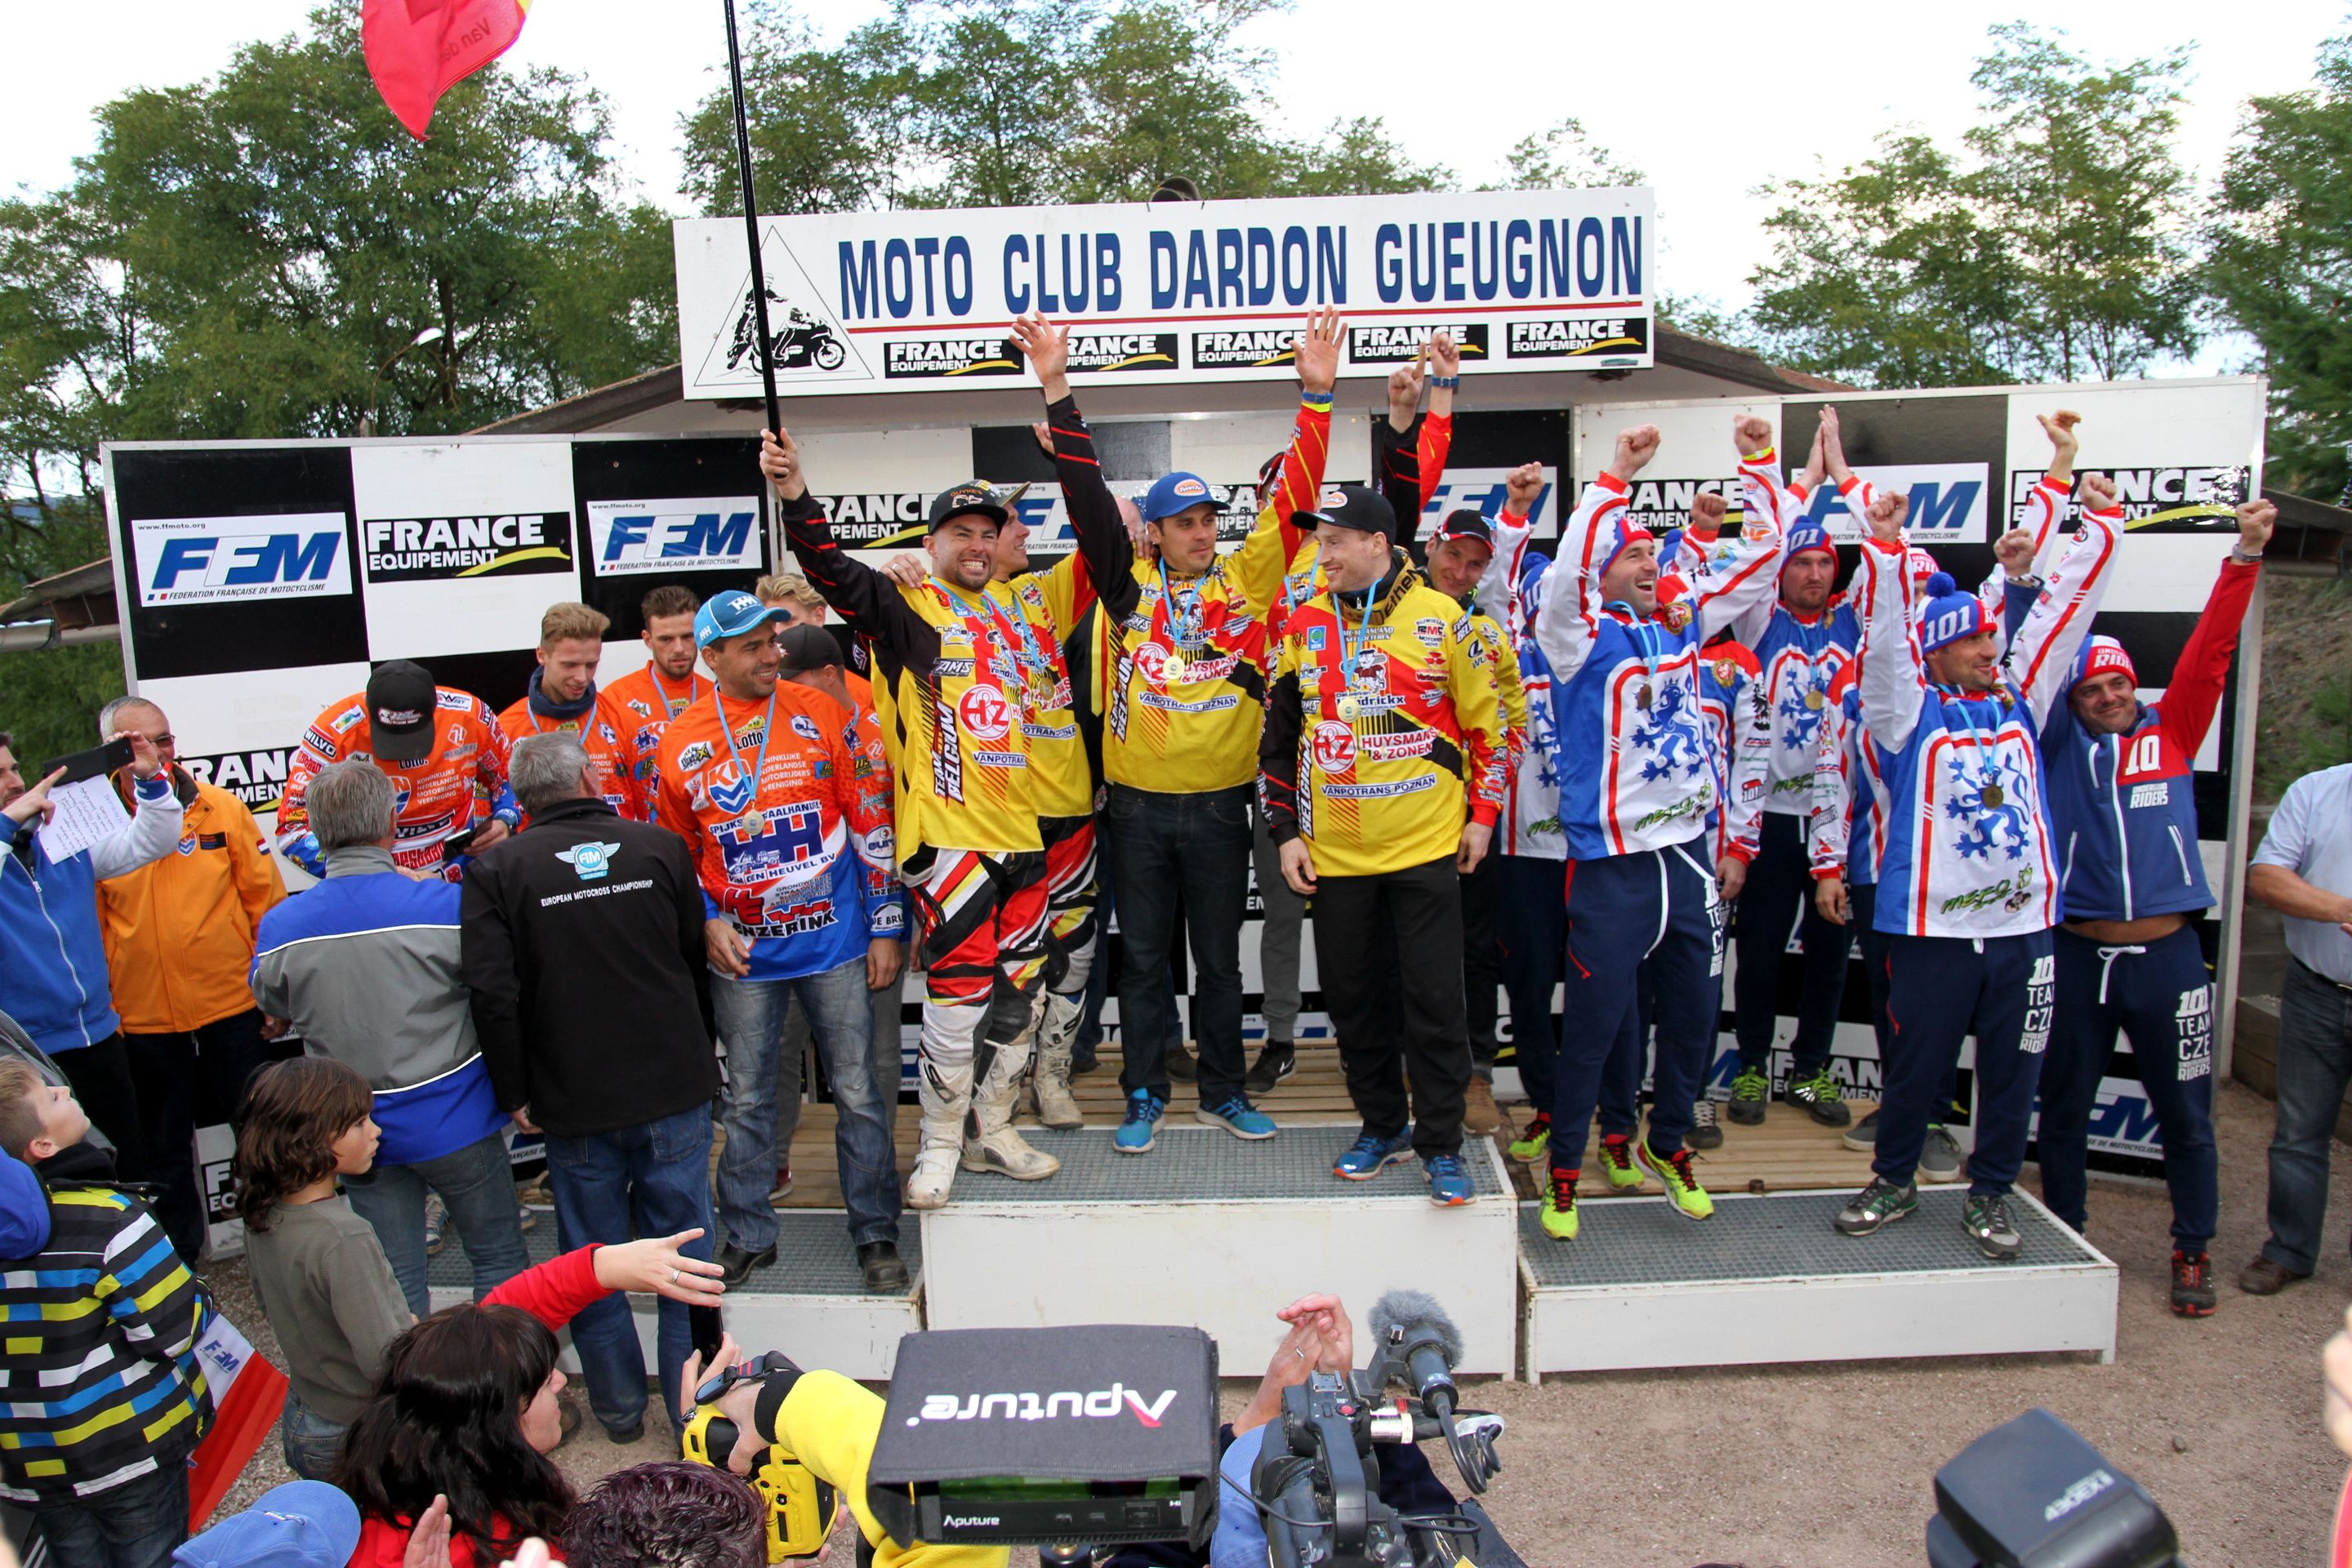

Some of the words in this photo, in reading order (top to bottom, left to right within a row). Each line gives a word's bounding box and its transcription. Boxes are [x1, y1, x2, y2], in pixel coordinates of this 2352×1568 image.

[839, 235, 973, 319] MOTO
[1004, 233, 1122, 314] CLUB
[1150, 225, 1348, 310] DARDON
[1376, 216, 1642, 303] GUEUGNON
[1512, 319, 1626, 341] FRANCE
[890, 340, 1003, 361] FRANCE
[1065, 335, 1157, 355] RANCE
[1355, 344, 1431, 358] EQUIPEME
[1512, 338, 1595, 353] EQUIPEMENT
[890, 359, 972, 372] EQUIPEMENT
[1066, 354, 1126, 367] IPEMENT
[1198, 350, 1281, 363] EQUIPEMENT
[591, 501, 647, 510] www.ffmoto.org
[821, 494, 930, 523] RANCE
[1807, 481, 1982, 528] FM
[137, 522, 207, 532] www.ffmoto.org
[368, 515, 545, 553] FRANCE
[604, 512, 756, 561] FFM
[830, 523, 902, 540] PEMENT
[1024, 542, 1049, 550] ERATION
[1049, 541, 1079, 550] FRANÇAIS
[1788, 528, 1818, 552] 01
[151, 532, 342, 590] FFM
[369, 548, 499, 571] EQUIPEMENT
[617, 561, 653, 571] FEDERATION
[653, 559, 687, 569] FRANÇAISE
[688, 559, 696, 567] DE
[697, 557, 741, 567] MOTOCYCLISME
[169, 588, 215, 601] FEDERATION
[216, 586, 257, 599] FRANÇAISE
[259, 585, 270, 595] DE
[270, 582, 327, 595] MOTOCYCLISME
[1163, 625, 1217, 643] Hdrickx
[1924, 605, 1971, 648] 101
[2093, 653, 2133, 670] RIDE
[304, 729, 336, 757] WILVO
[1361, 728, 1438, 749] HUYSMANS
[758, 752, 801, 766] ONINKLIJKE
[938, 702, 964, 804] BELGIUM
[973, 752, 1027, 765] VANPOTRA
[1372, 751, 1380, 761] &
[1387, 743, 1433, 760] ZONEN
[1322, 784, 1392, 796] VANPOTRANS
[1394, 776, 1437, 793] POZNAN
[417, 790, 457, 805] VERENIGING
[2130, 791, 2169, 809] RIDERS
[579, 850, 601, 864] FIM
[746, 870, 765, 882] DEN
[768, 860, 818, 878] HEUVEL
[820, 853, 836, 864] BV
[541, 891, 572, 907] EUROPEAN
[574, 886, 611, 900] MOTOCROSS
[612, 880, 653, 894] CHAMPIONSHIP
[2027, 985, 2055, 1007] TEA
[2176, 1014, 2211, 1037] TEAM
[2178, 1033, 2211, 1062] CZE
[2177, 1063, 2211, 1081] RIDERS
[920, 1382, 1178, 1429] Aputure
[942, 1514, 1000, 1528] Aputure
